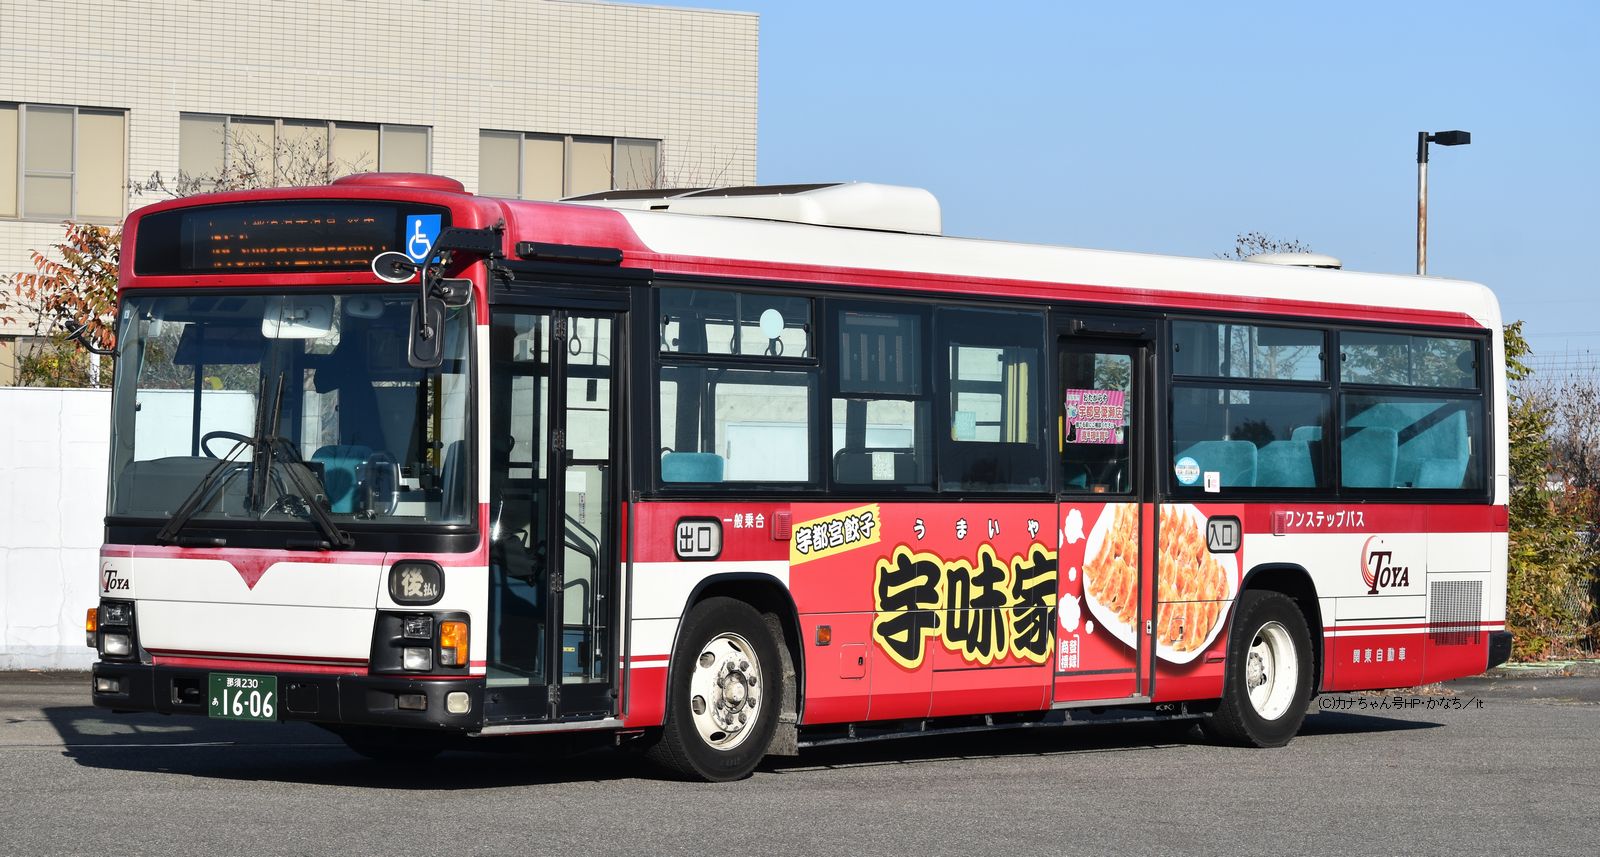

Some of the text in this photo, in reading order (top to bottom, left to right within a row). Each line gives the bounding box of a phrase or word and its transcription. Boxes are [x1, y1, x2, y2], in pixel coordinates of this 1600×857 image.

[723, 512, 765, 529] 一般乗合
[913, 518, 1040, 539] うまいや
[1285, 510, 1365, 528] ワンステップバス
[679, 526, 711, 553] 出口
[795, 511, 876, 555] 宇都宮餃子
[1208, 523, 1232, 547] 入口
[103, 569, 130, 592] TOYA
[401, 567, 437, 597] 後払し
[1367, 551, 1410, 595] TOYA
[877, 551, 1055, 657] 宇味家
[1352, 648, 1406, 664] 関東自動車
[226, 677, 258, 688] 那須230
[211, 689, 273, 718] あ 16-06
